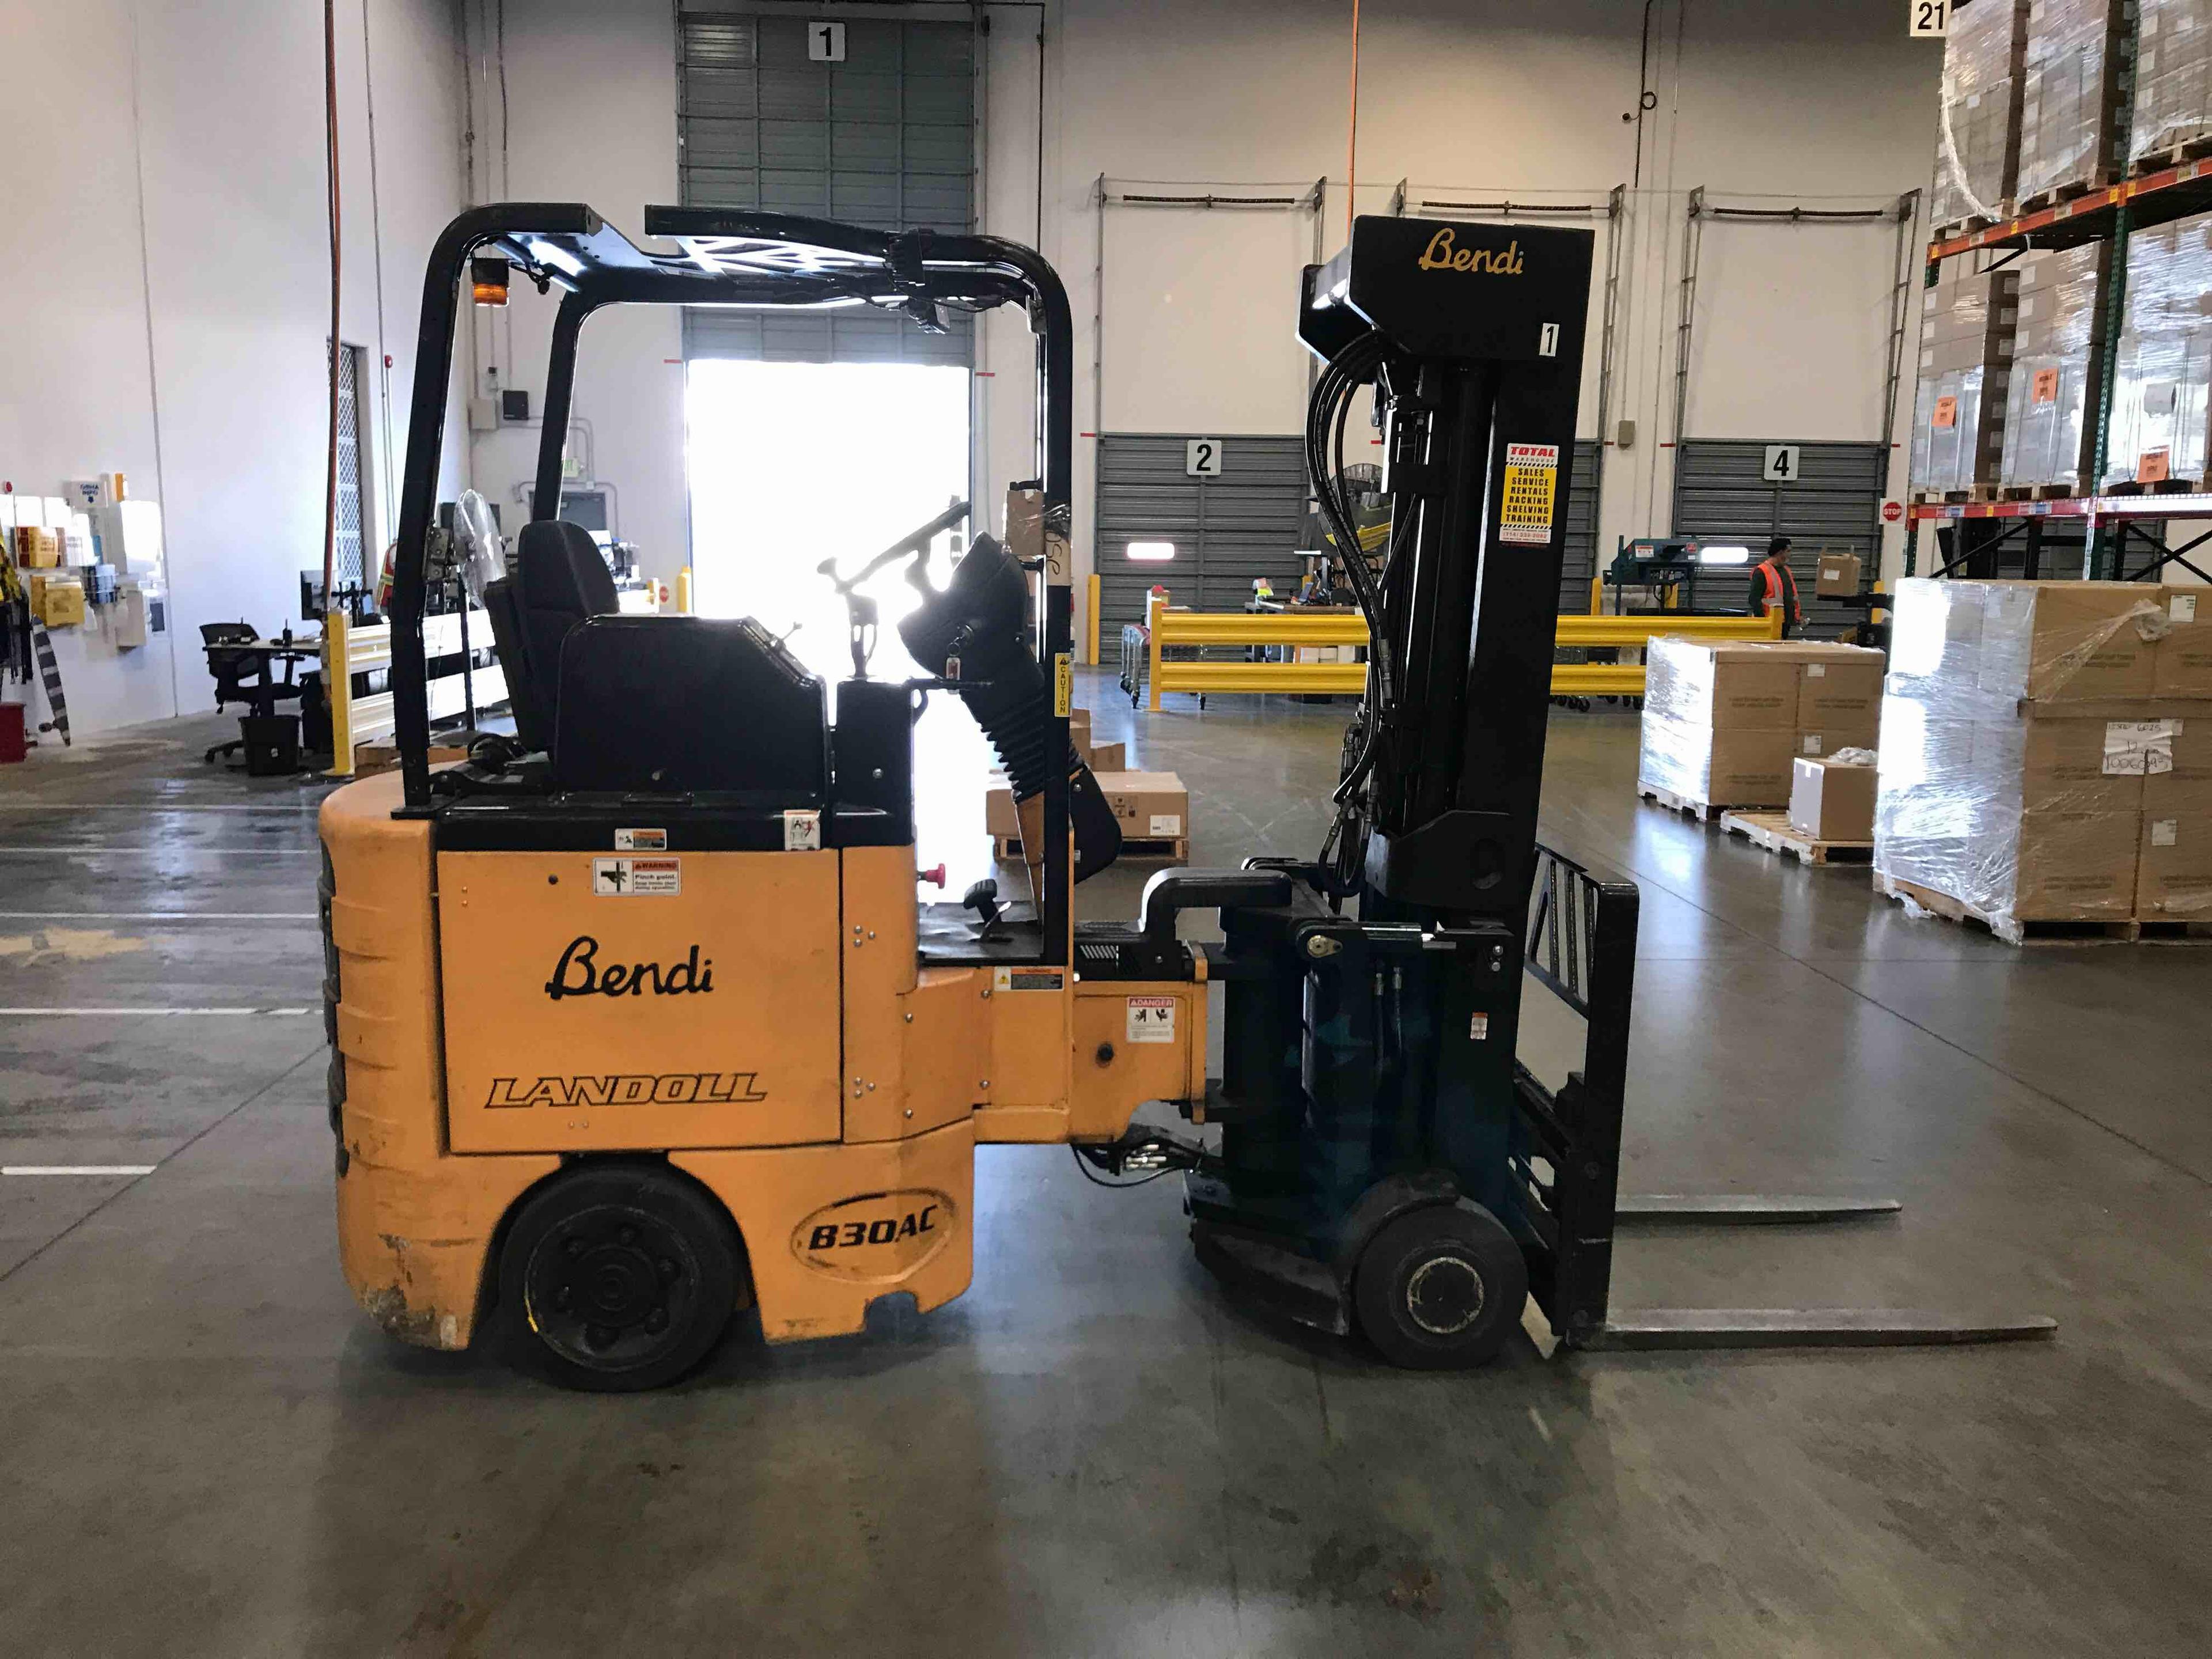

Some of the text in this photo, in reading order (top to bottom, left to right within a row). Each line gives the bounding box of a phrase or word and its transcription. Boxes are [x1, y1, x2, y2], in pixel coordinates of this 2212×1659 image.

[1918, 1, 1944, 29] 21
[819, 26, 831, 56] 1
[1418, 228, 1524, 274] Bendi
[1547, 326, 1554, 353] 1
[1196, 444, 1211, 471] 2
[1510, 446, 1555, 457] TOTAL
[1773, 450, 1790, 476] 4
[1512, 477, 1549, 486] SERVICE
[1518, 468, 1544, 476] SALES
[1509, 496, 1548, 505] RACKING
[1510, 487, 1548, 495] RENTALS
[1506, 505, 1549, 514] SHELVING
[1506, 514, 1548, 524] TRAINING
[544, 935, 714, 1000] Bendi
[1137, 999, 1172, 1007] DANGER
[484, 1072, 768, 1109] LANDOLL
[808, 1204, 938, 1250] B30AC
